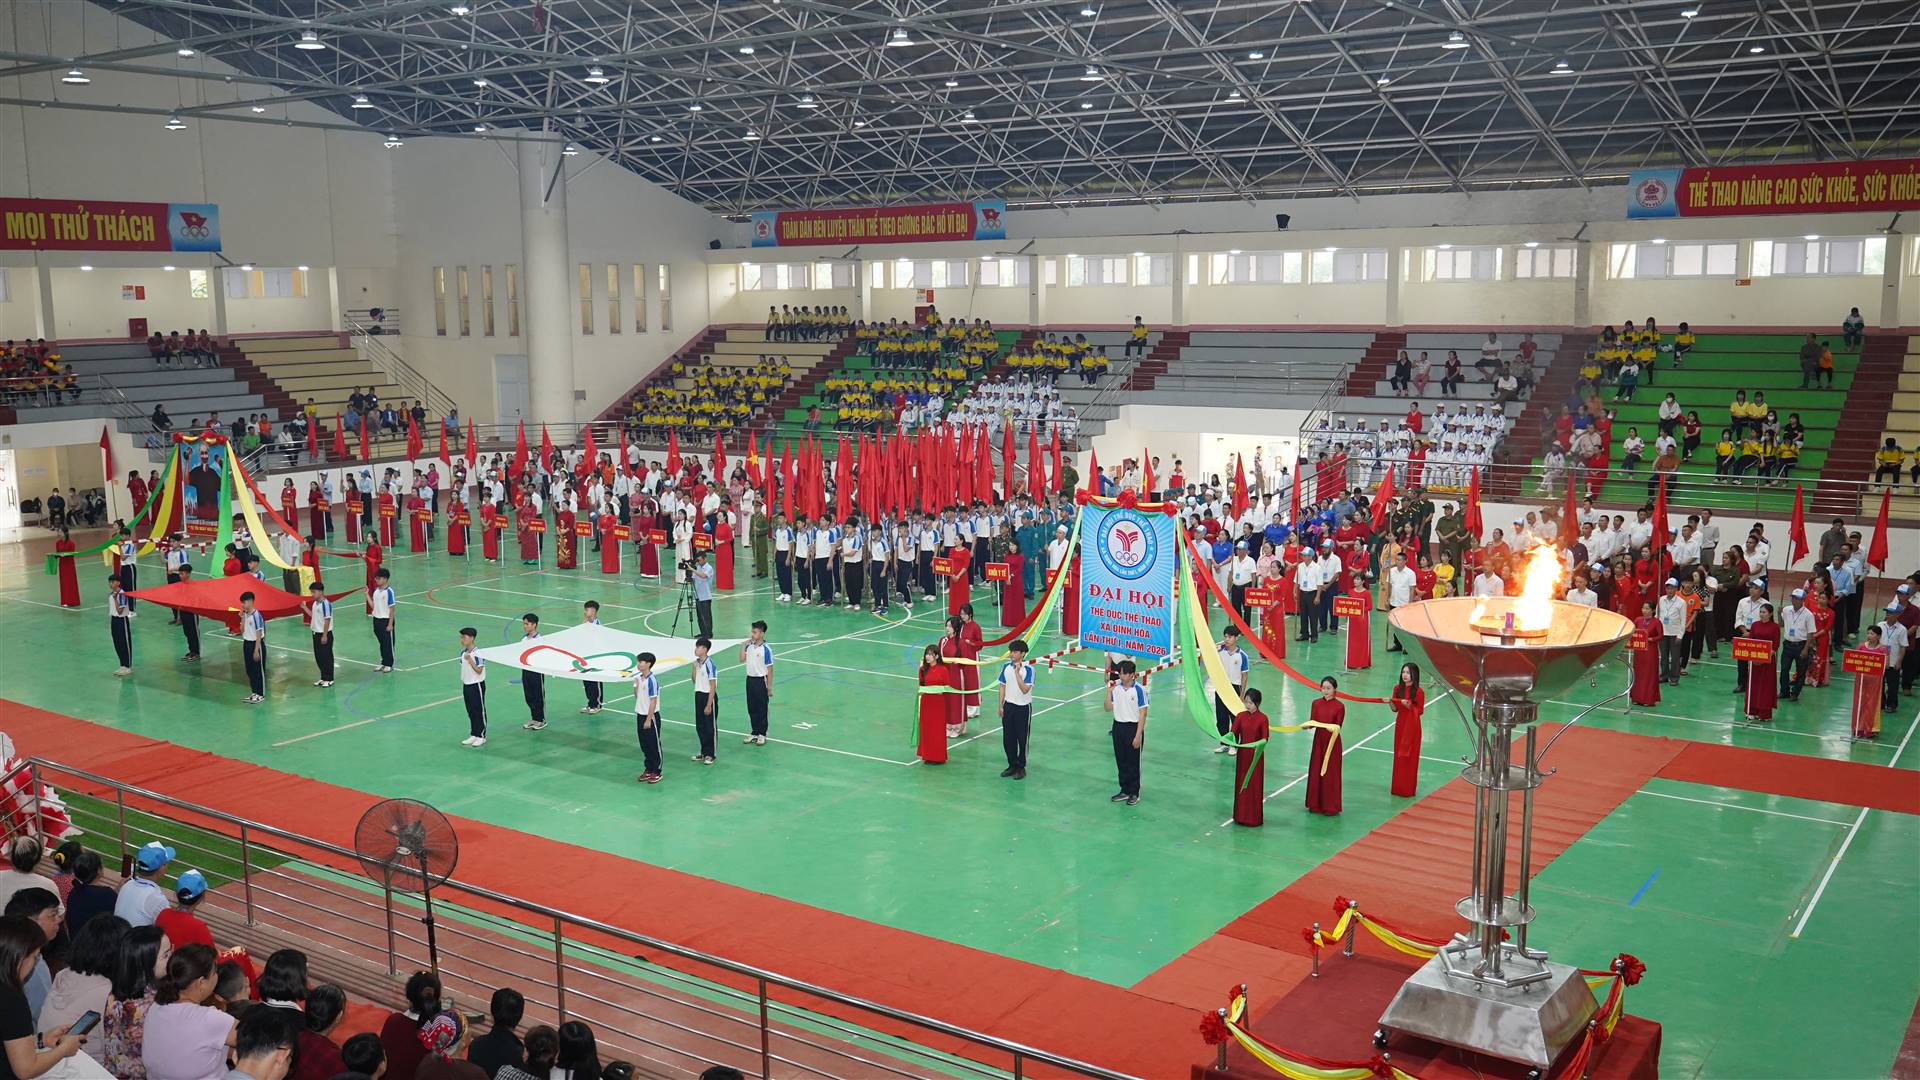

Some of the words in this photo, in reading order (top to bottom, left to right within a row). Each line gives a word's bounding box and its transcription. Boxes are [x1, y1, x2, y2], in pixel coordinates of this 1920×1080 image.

[1689, 170, 1710, 208] THỂ
[1712, 180, 1738, 207] THAO
[1741, 174, 1772, 206] NÂNG
[1775, 178, 1798, 205] CAO
[1800, 172, 1823, 204] SỨC
[1826, 168, 1859, 206] KHỎE,
[1863, 169, 1887, 202] SỨC
[1890, 164, 1920, 200] KHỎE
[5, 212, 46, 246] MỌI
[51, 205, 89, 241] THỬ
[94, 210, 155, 242] THÁCH
[782, 217, 798, 239] TOÀN
[800, 216, 812, 238] DÂN
[814, 216, 826, 238] RÈN
[827, 216, 846, 242] LUYỆN
[848, 214, 865, 237] THÂN
[880, 216, 896, 236] THEO
[922, 211, 935, 234] BÁC
[1089, 584, 1122, 602] ĐẠI
[1128, 590, 1164, 609] HỘI
[1142, 616, 1162, 627] THAO
[1146, 645, 1166, 656] 2026
